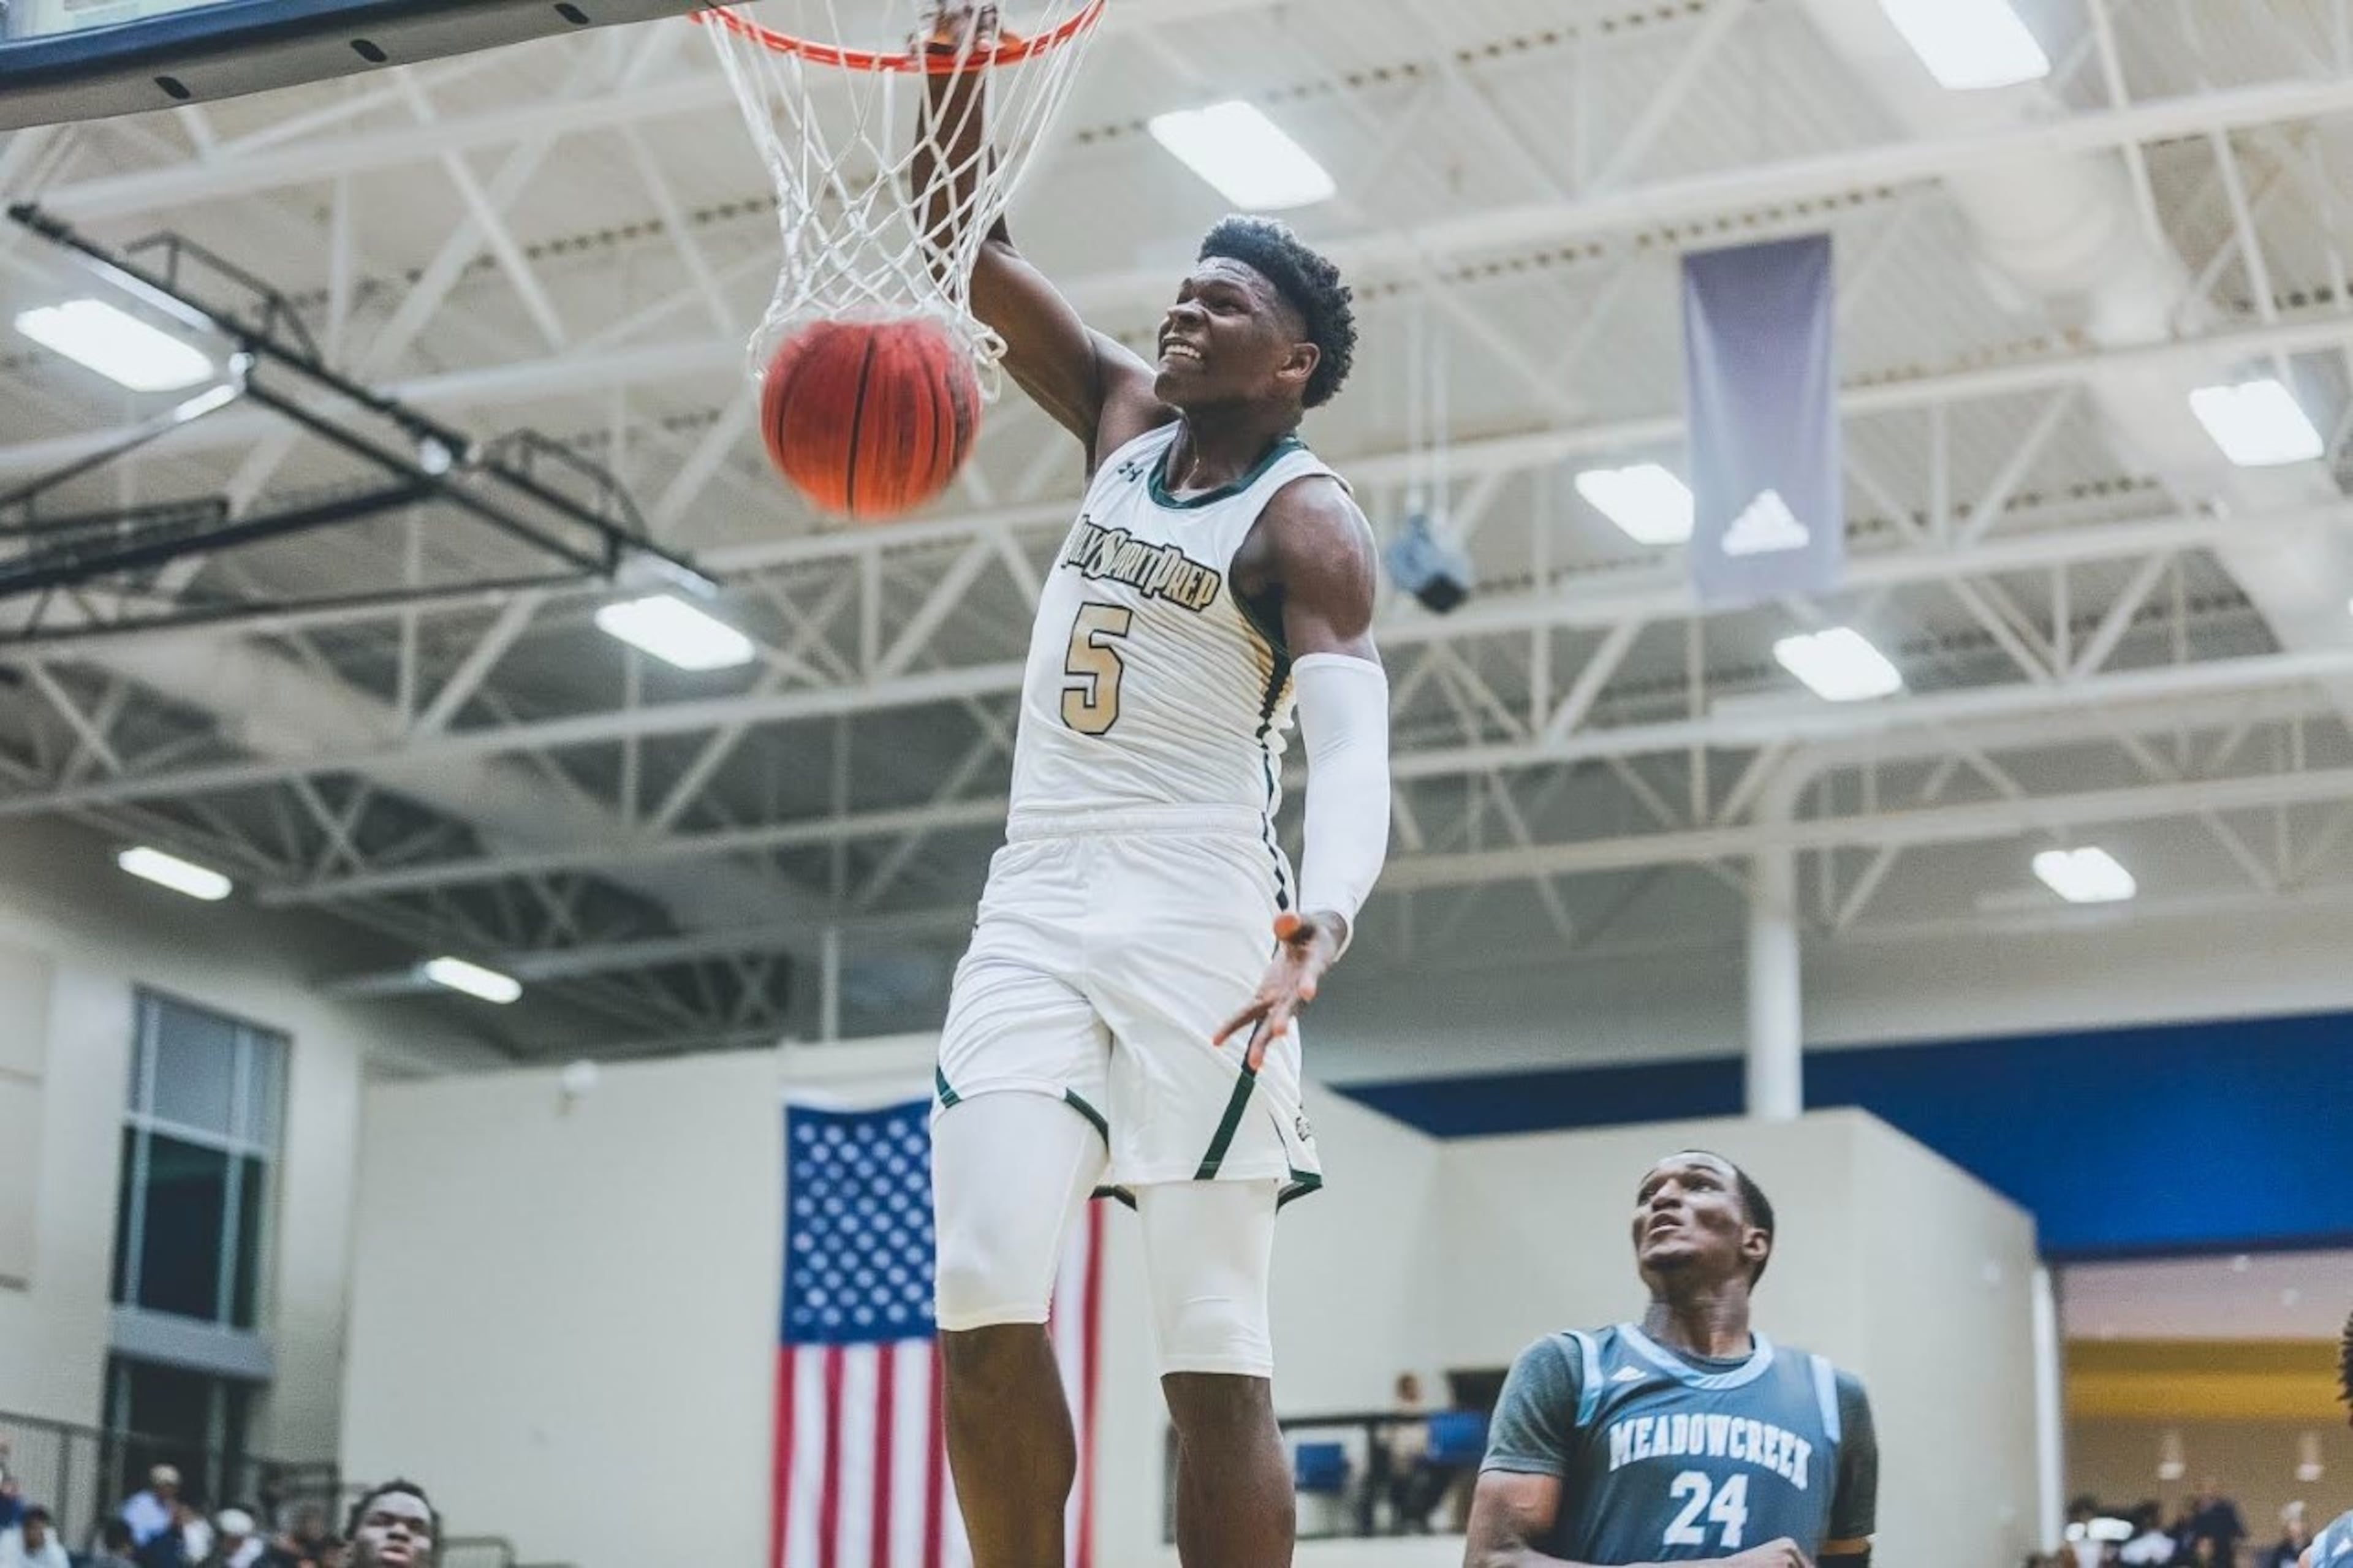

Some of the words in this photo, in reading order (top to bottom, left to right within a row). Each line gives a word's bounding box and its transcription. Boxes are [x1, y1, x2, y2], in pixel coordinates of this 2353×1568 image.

[1061, 601, 1134, 735] 5
[1608, 1412, 1812, 1491] MEADOWCREEK
[1662, 1470, 1749, 1549] 24
